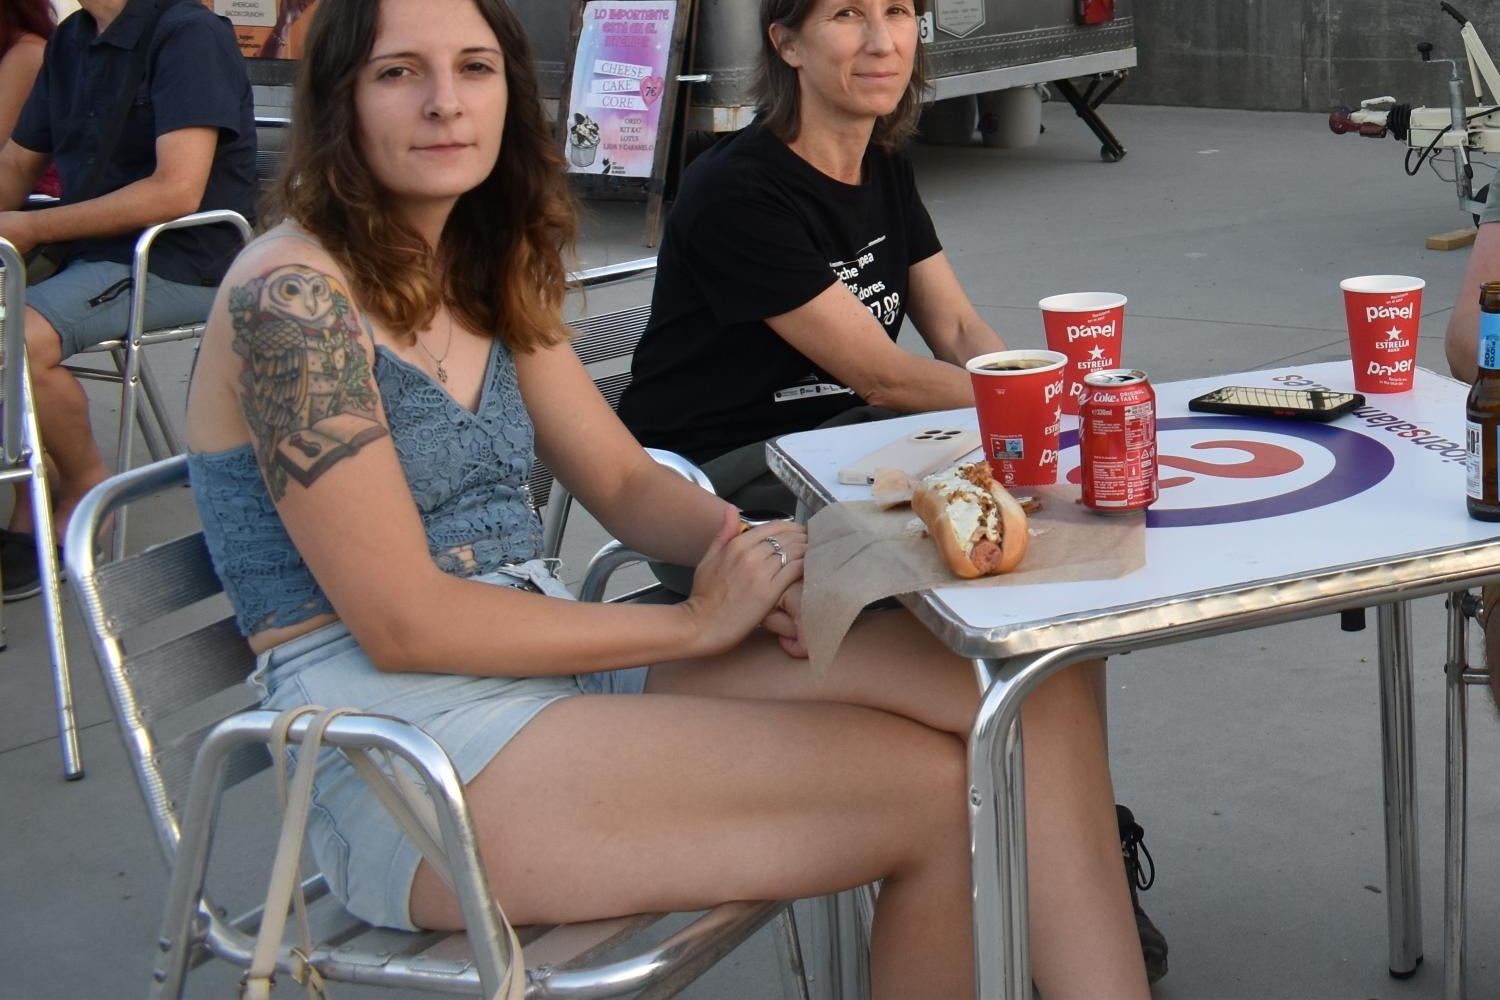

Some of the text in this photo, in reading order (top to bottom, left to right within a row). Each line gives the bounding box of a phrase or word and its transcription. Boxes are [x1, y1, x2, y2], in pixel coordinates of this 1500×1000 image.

[595, 9, 607, 20] LO
[602, 63, 644, 77] CHEESE
[602, 81, 633, 91] CAKE
[646, 87, 656, 96] 7€
[602, 97, 633, 108] CORE
[1376, 340, 1409, 349] ESTRELLA
[1078, 358, 1113, 369] ESTRELLA
[1094, 392, 1117, 402] Coke
